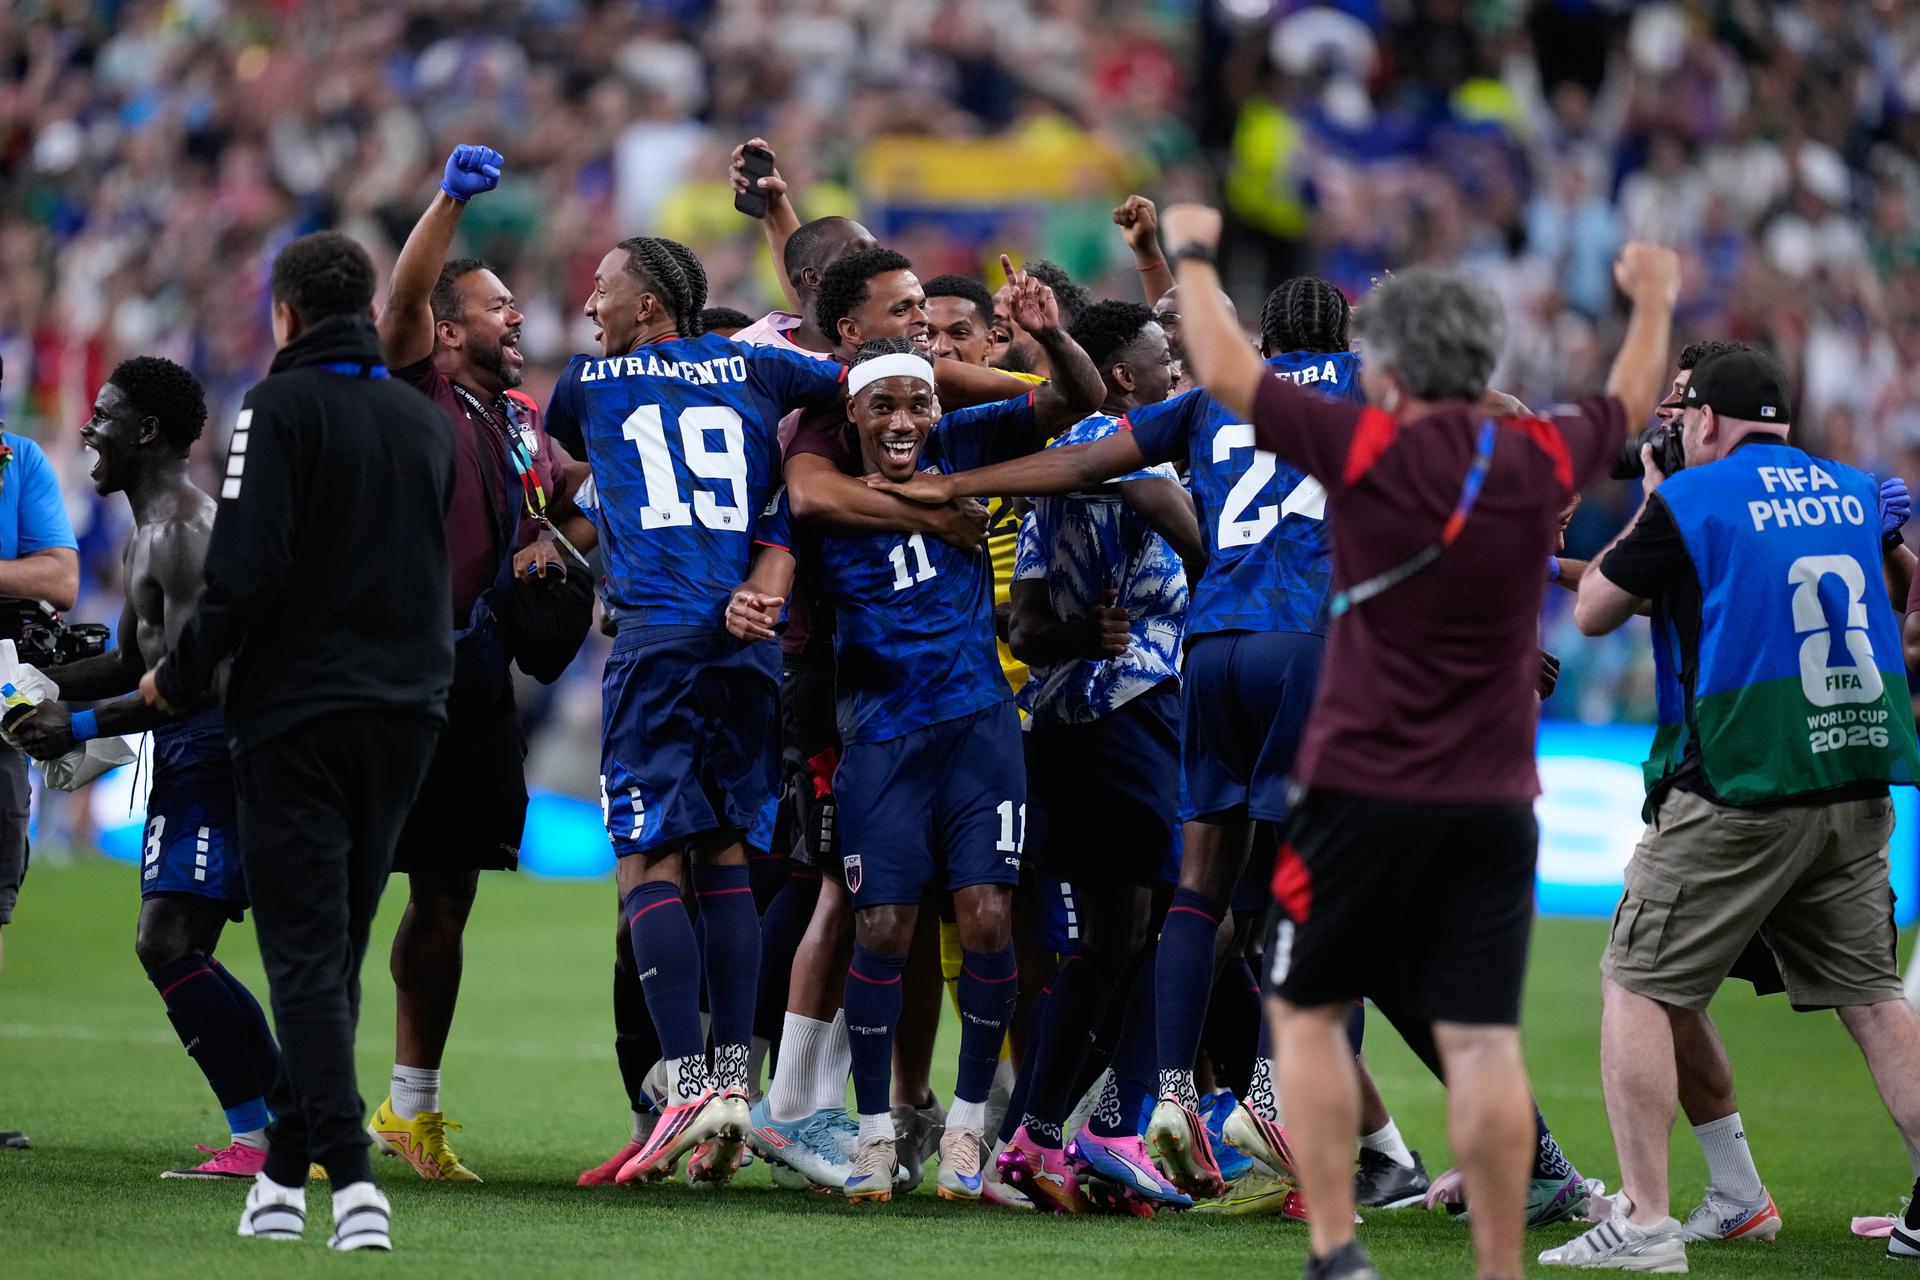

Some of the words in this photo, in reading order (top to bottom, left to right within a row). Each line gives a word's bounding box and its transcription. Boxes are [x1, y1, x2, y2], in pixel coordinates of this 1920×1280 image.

[580, 355, 747, 385] LIVRAMENTO
[465, 392, 485, 414] WORLD
[622, 404, 748, 532] 19
[1757, 464, 1838, 493] FIFA
[1747, 495, 1864, 532] PHOTO
[887, 531, 937, 591] 11
[1826, 674, 1863, 691] FIFA
[1807, 710, 1857, 730] WORLD
[1860, 709, 1889, 724] CUP
[1809, 726, 1889, 754] 2026
